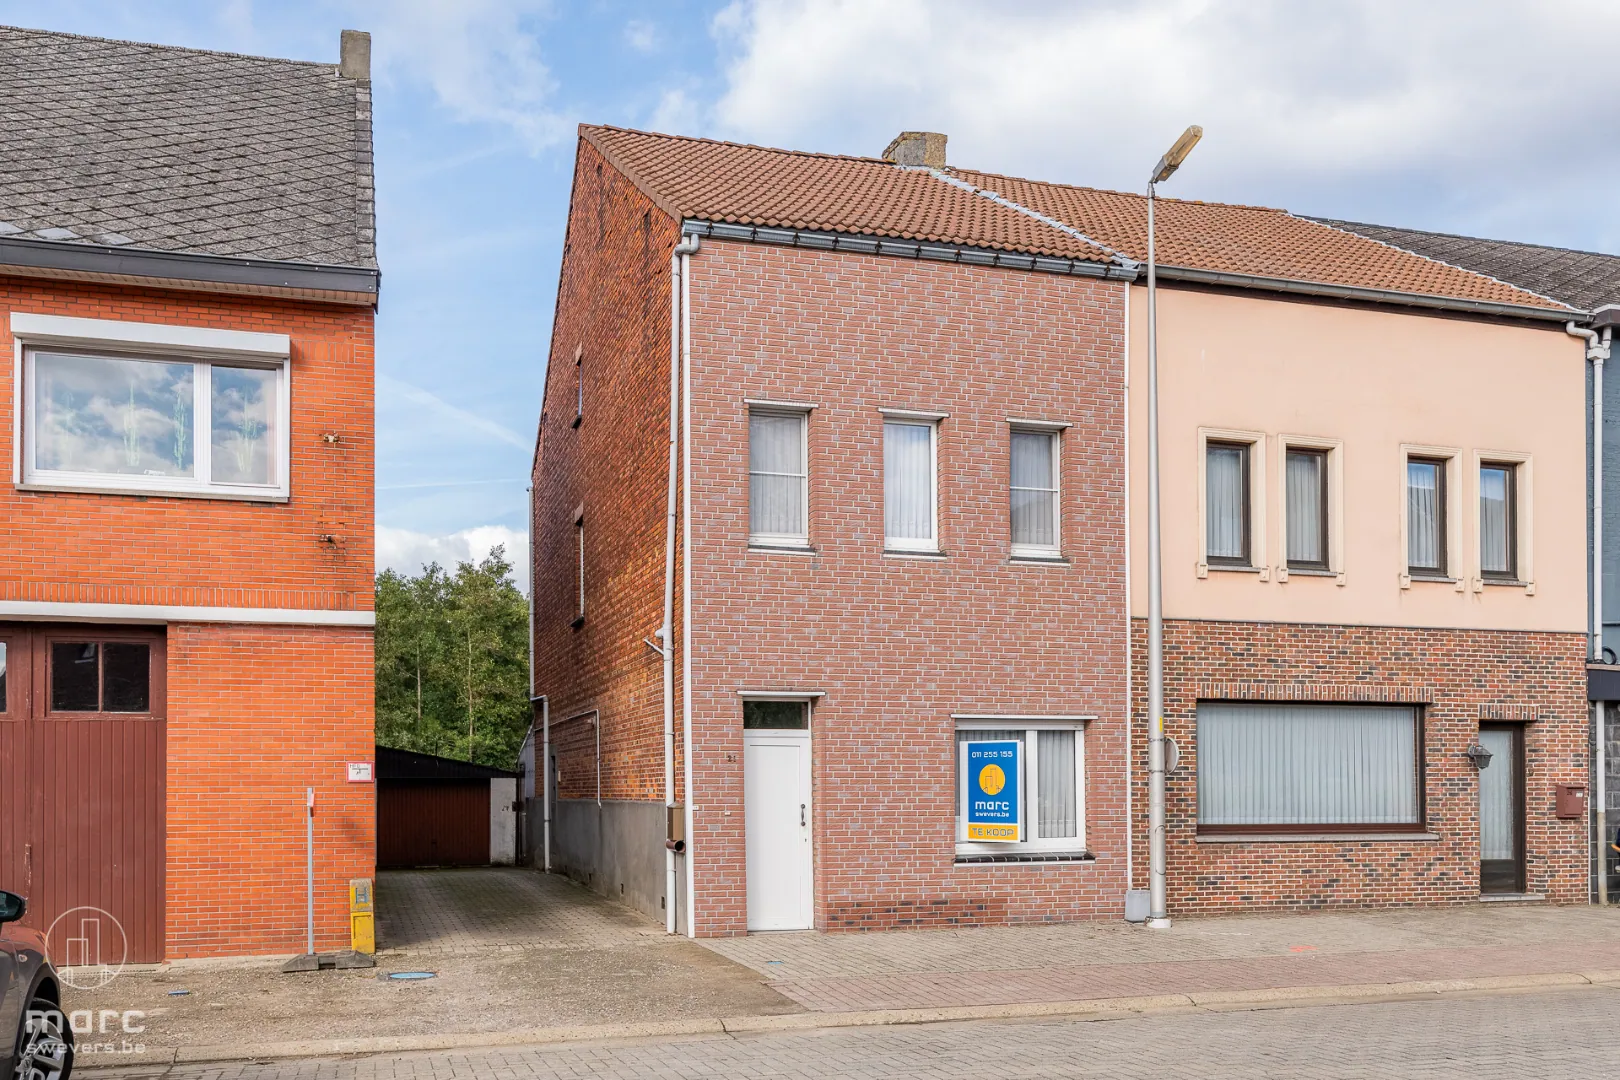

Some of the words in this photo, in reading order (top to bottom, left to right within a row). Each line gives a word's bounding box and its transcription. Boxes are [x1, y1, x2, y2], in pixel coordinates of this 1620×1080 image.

[1000, 750, 1013, 758] 155
[975, 801, 1010, 811] marc
[972, 828, 984, 836] TE
[986, 828, 1014, 837] KOOP
